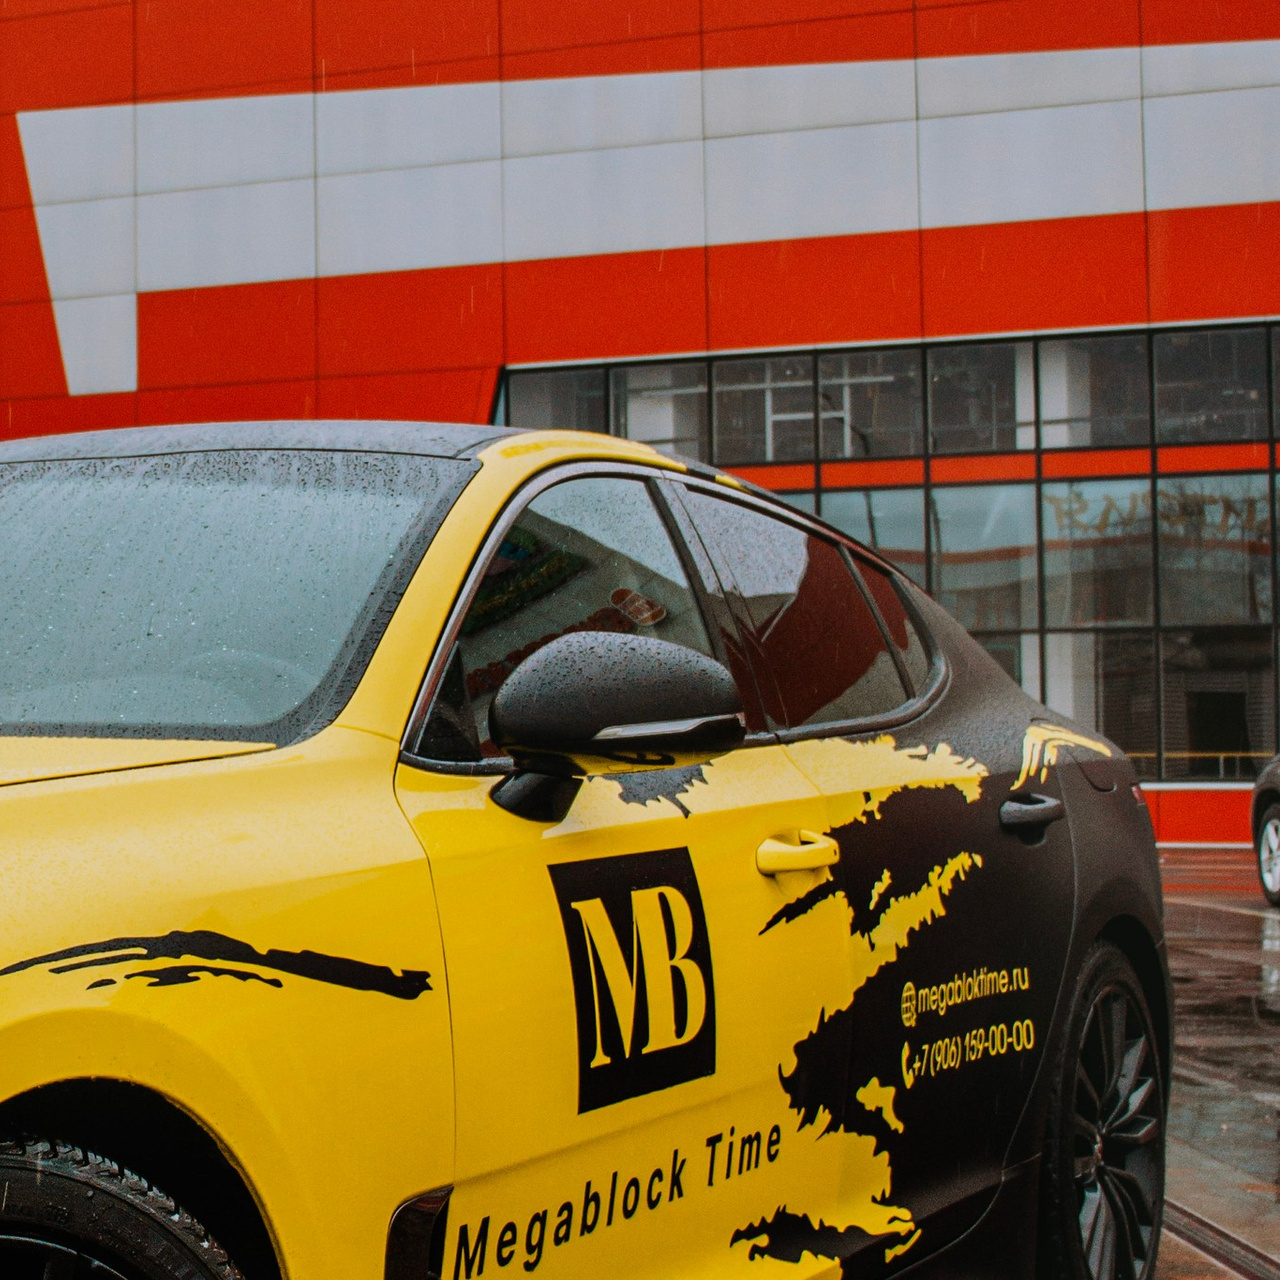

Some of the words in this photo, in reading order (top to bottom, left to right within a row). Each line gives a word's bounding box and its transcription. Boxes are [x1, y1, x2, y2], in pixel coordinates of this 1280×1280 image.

[571, 885, 707, 1069] MB
[917, 967, 1030, 1016] megabloktime.ru
[912, 1044, 929, 1076] +7
[930, 1036, 962, 1077] (906)
[964, 1019, 1035, 1062] 159-00-00
[705, 1123, 782, 1188] Time
